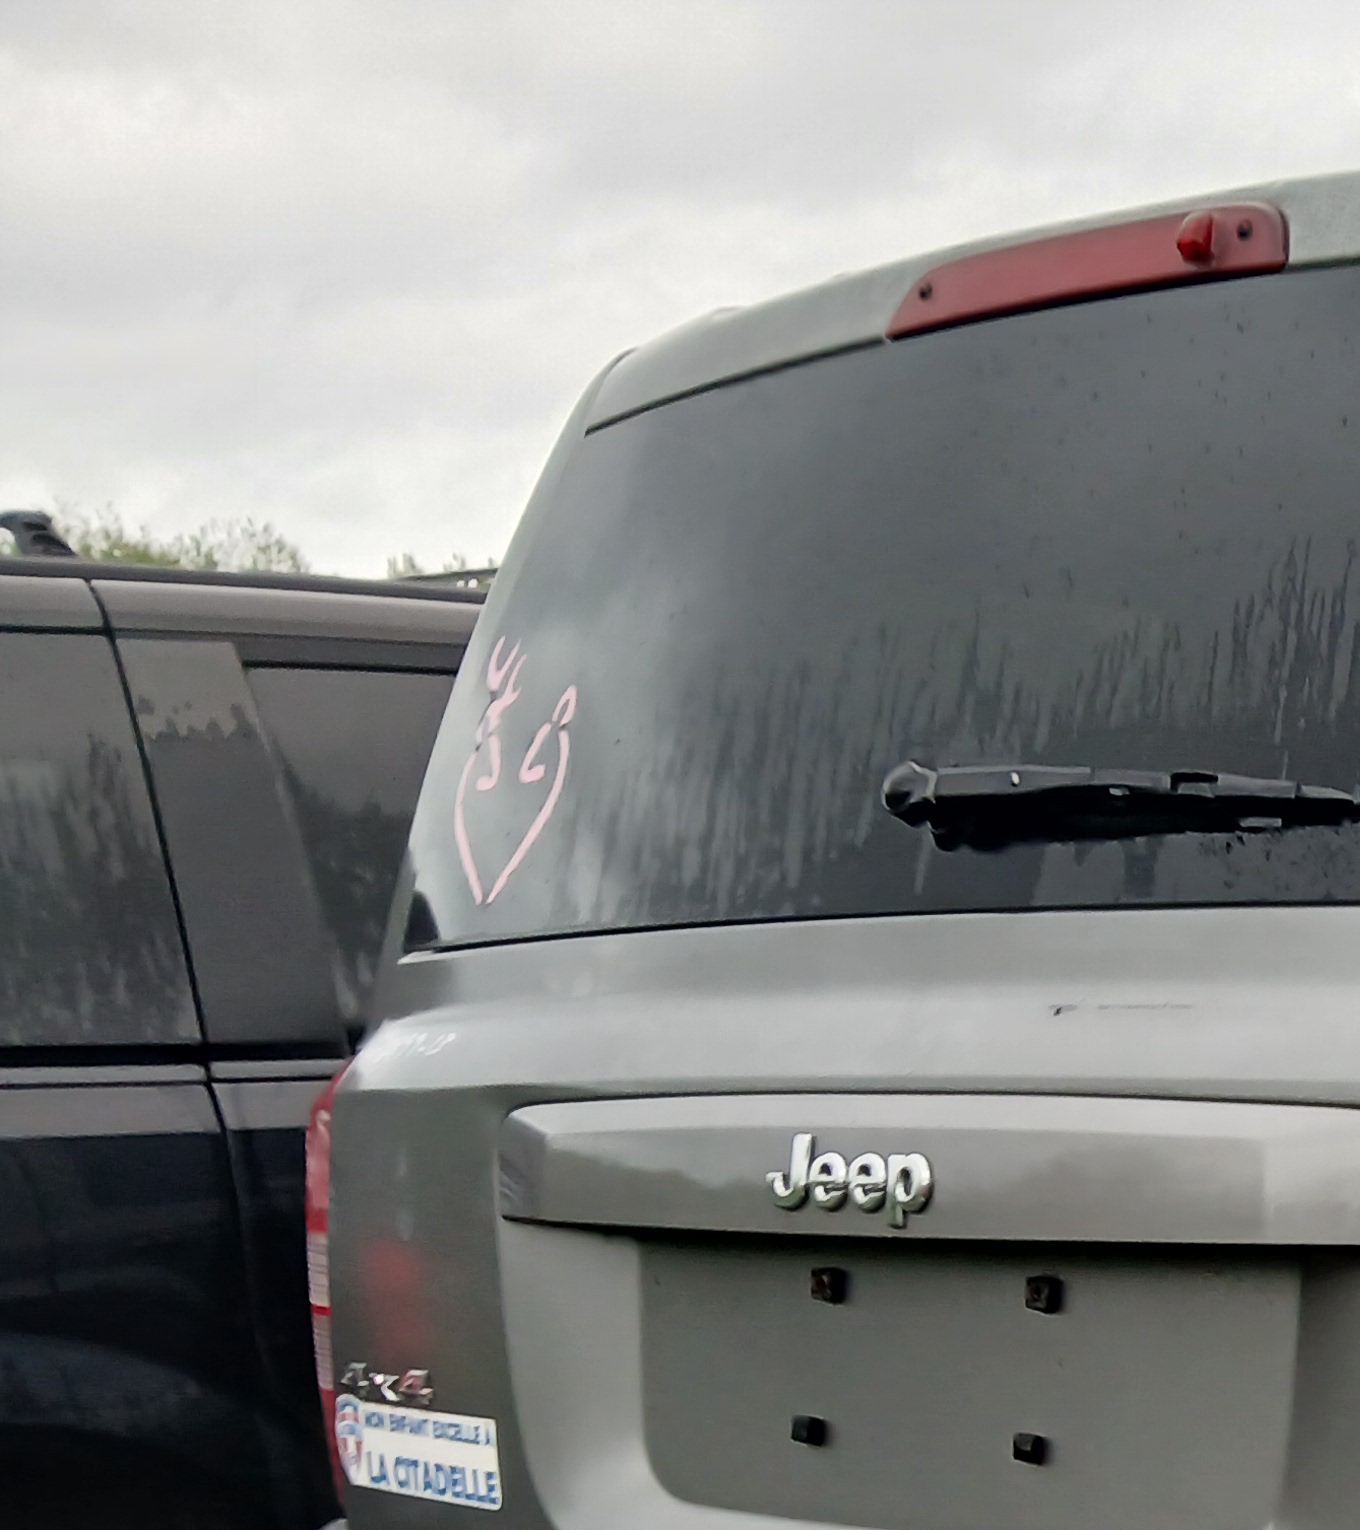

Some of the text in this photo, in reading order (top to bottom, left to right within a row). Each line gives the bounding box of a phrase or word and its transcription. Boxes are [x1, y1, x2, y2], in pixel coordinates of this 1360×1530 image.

[765, 1132, 935, 1228] Jeep
[366, 1450, 499, 1505] LA CITADELLE
